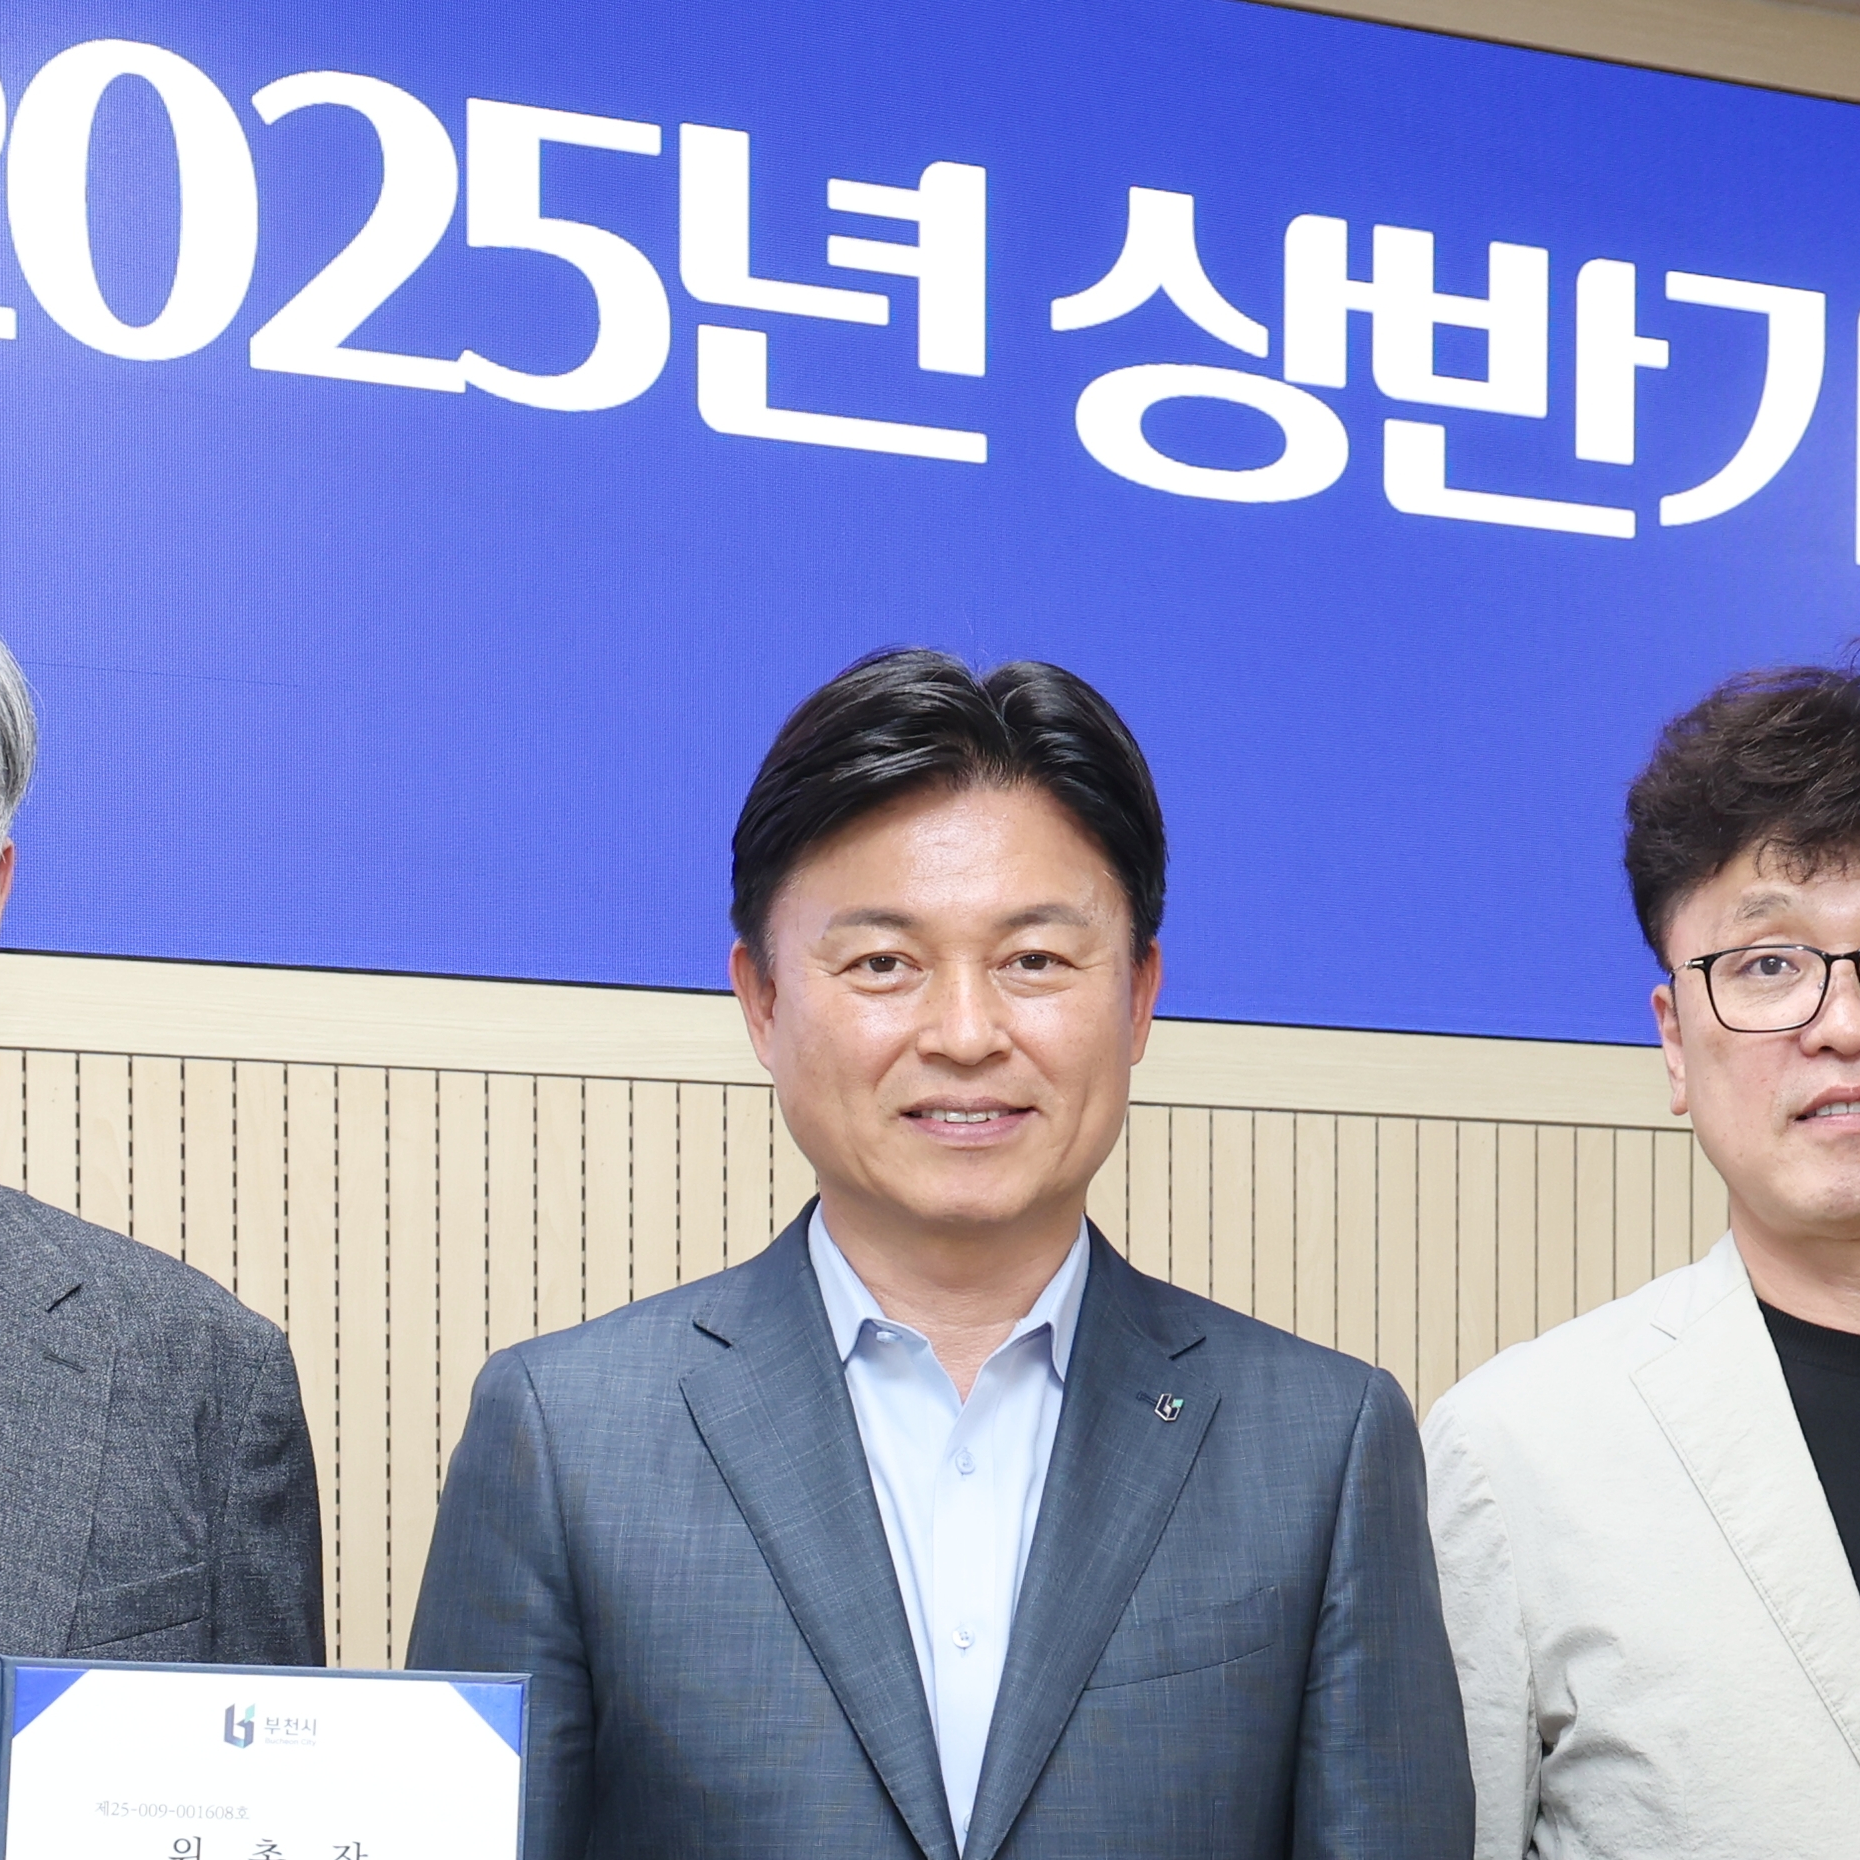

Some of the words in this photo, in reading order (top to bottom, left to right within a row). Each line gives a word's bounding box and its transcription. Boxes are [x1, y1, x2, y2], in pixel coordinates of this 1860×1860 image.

[264, 1716, 317, 1737] 부천시
[264, 1737, 299, 1746] Bucheon
[301, 1738, 317, 1747] City
[95, 1800, 250, 1821] 제25-009-001608호
